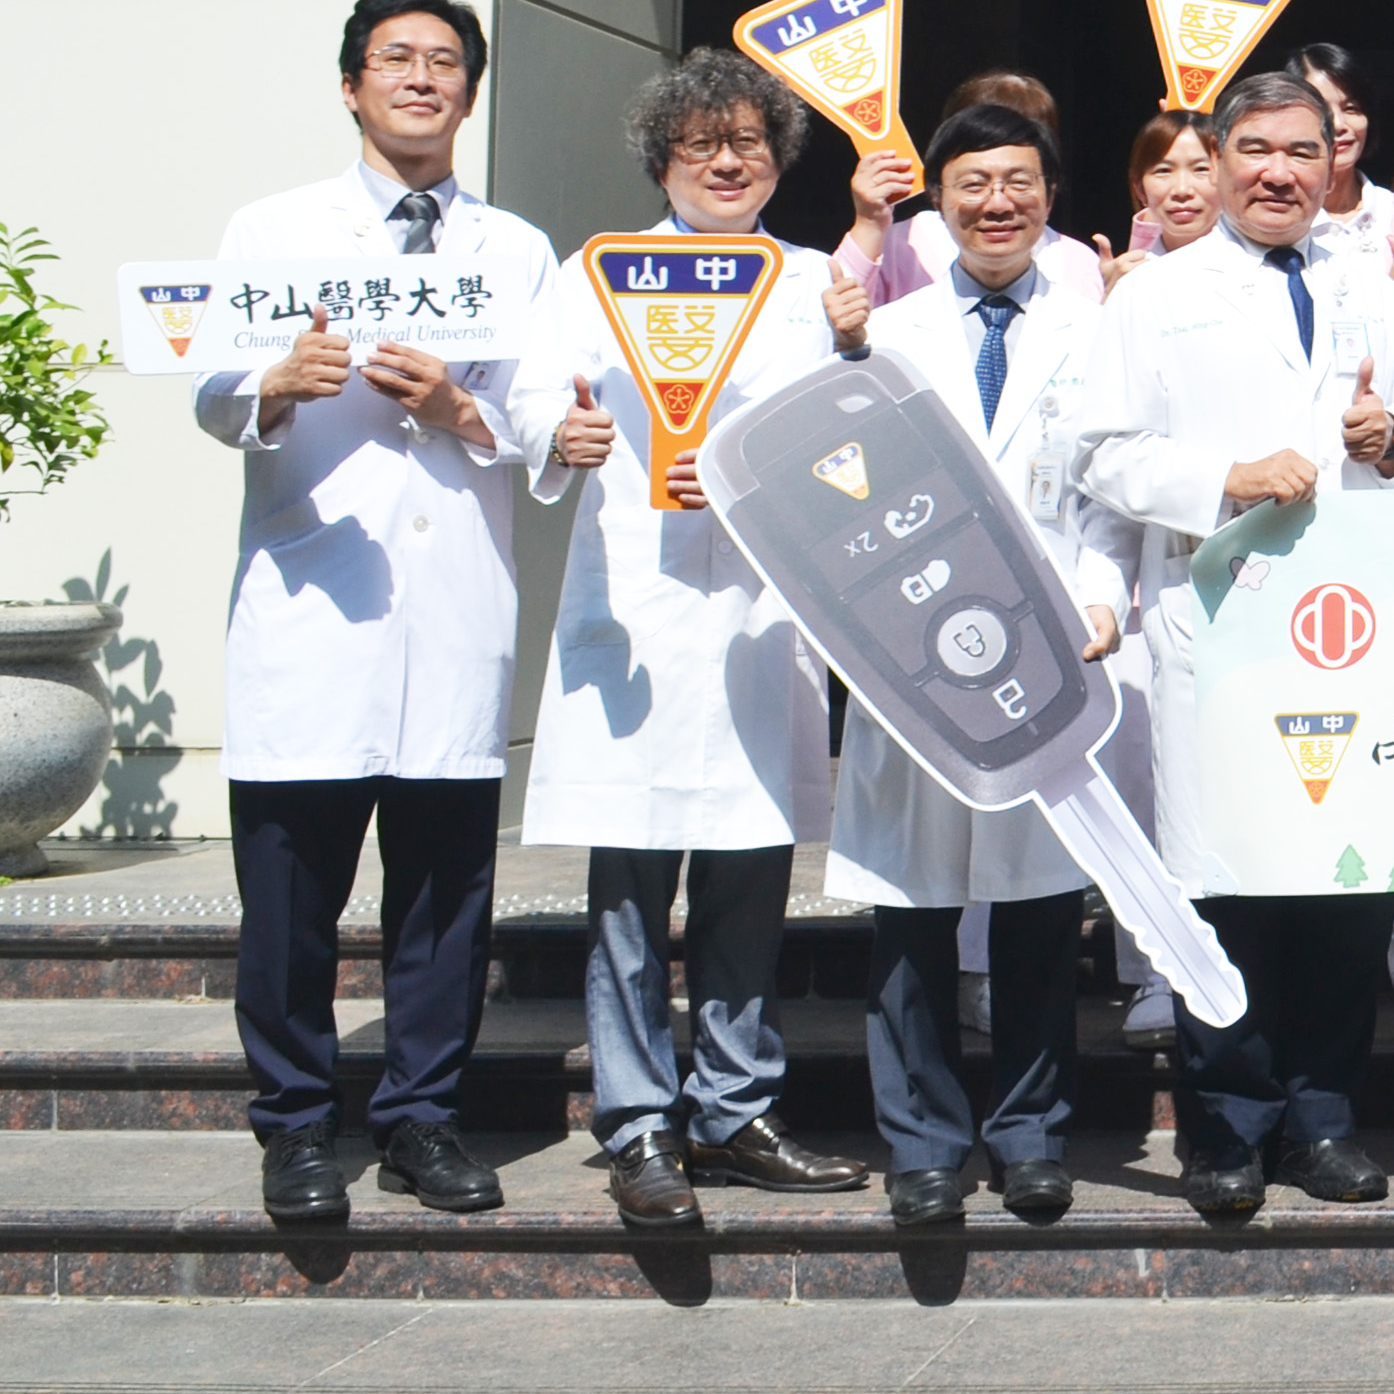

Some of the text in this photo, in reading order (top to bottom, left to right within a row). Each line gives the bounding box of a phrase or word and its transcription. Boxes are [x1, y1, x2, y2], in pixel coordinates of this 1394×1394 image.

[230, 274, 493, 324] 中山醫學大學
[234, 329, 290, 350] Chung
[346, 326, 411, 344] Medical
[417, 324, 497, 342] University
